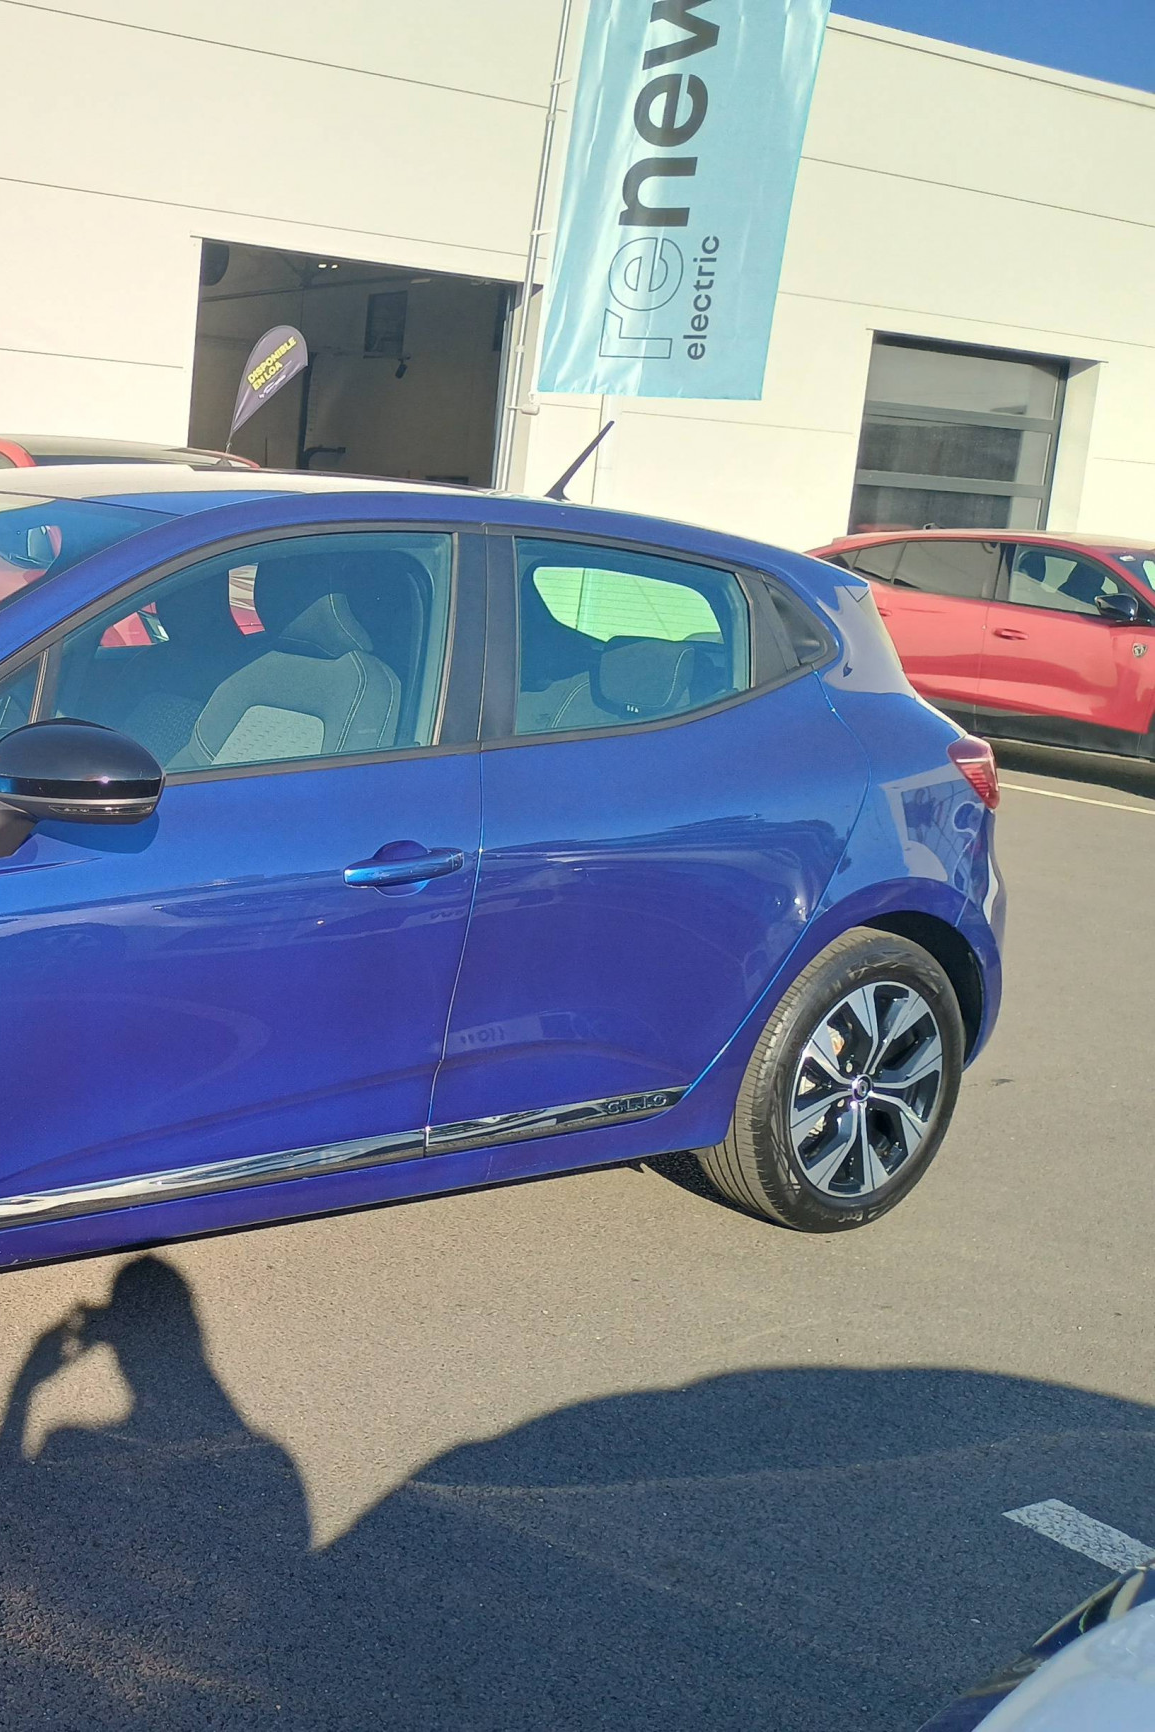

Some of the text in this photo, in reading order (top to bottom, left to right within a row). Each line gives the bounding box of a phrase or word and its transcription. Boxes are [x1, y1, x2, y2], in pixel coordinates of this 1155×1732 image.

[683, 235, 720, 360] electric
[247, 336, 297, 384] DISPONIBLE
[252, 376, 266, 391] EN
[263, 361, 283, 380] LOA
